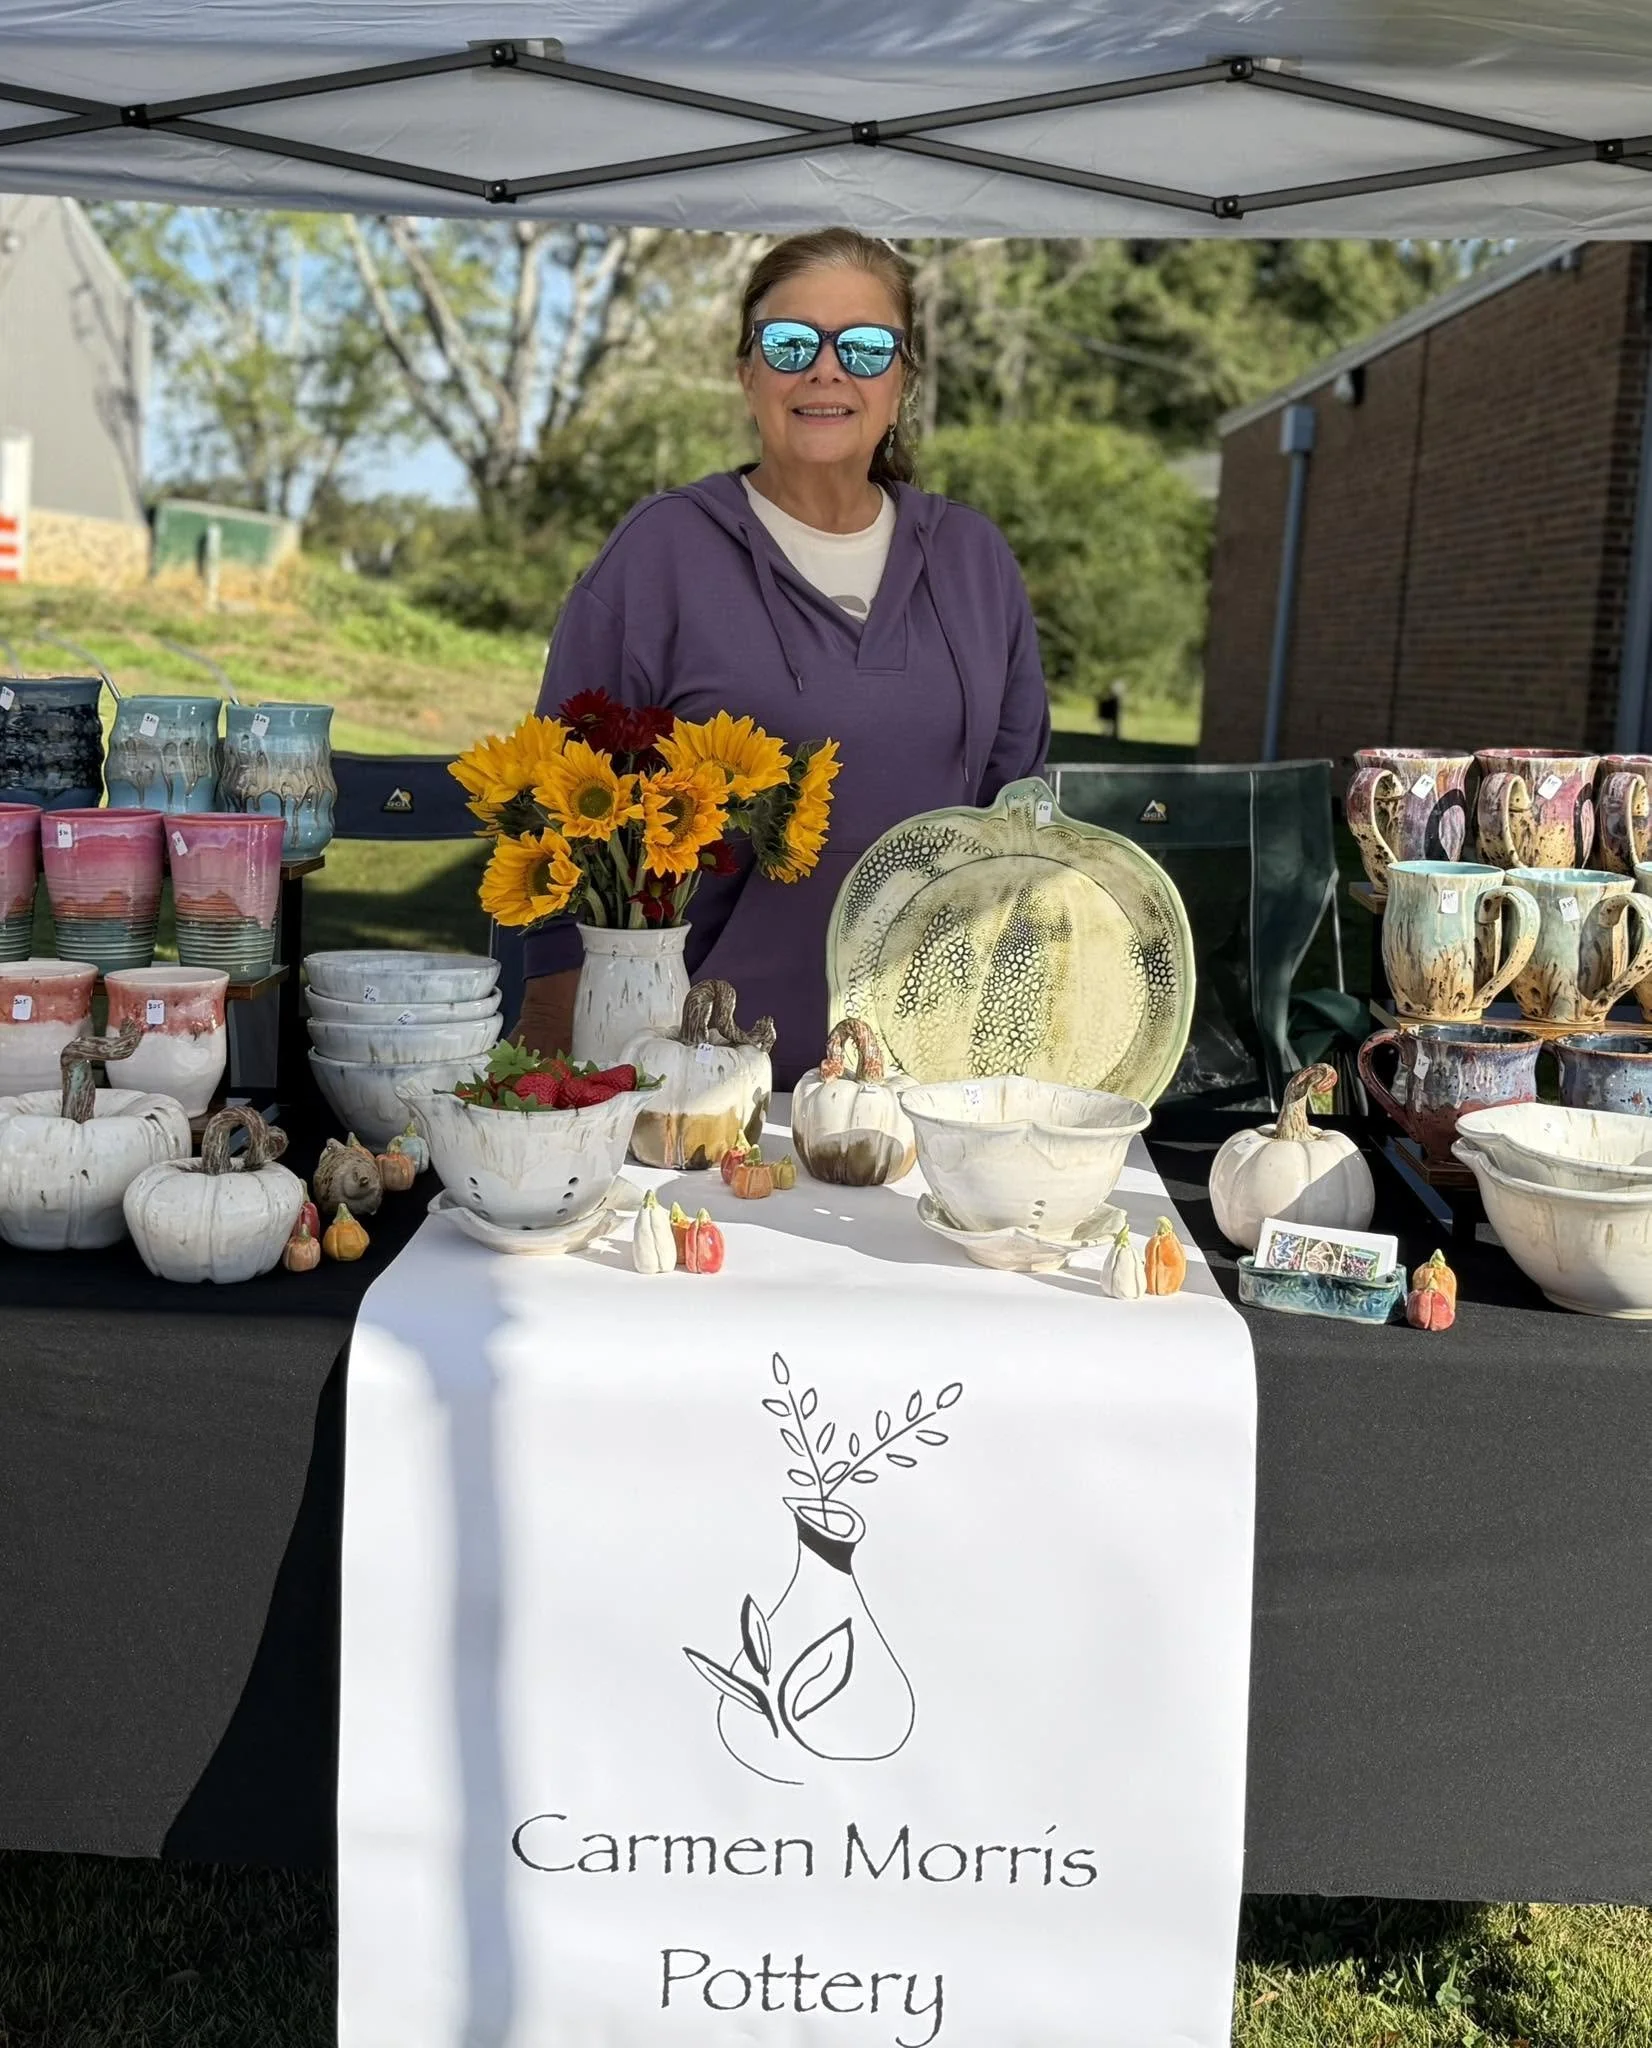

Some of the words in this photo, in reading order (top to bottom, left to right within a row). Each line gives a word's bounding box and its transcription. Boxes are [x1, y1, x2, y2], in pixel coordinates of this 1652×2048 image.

[511, 1814, 813, 1877] Carmen
[844, 1823, 1097, 1887] Morris
[661, 1949, 943, 2048] Pottery
